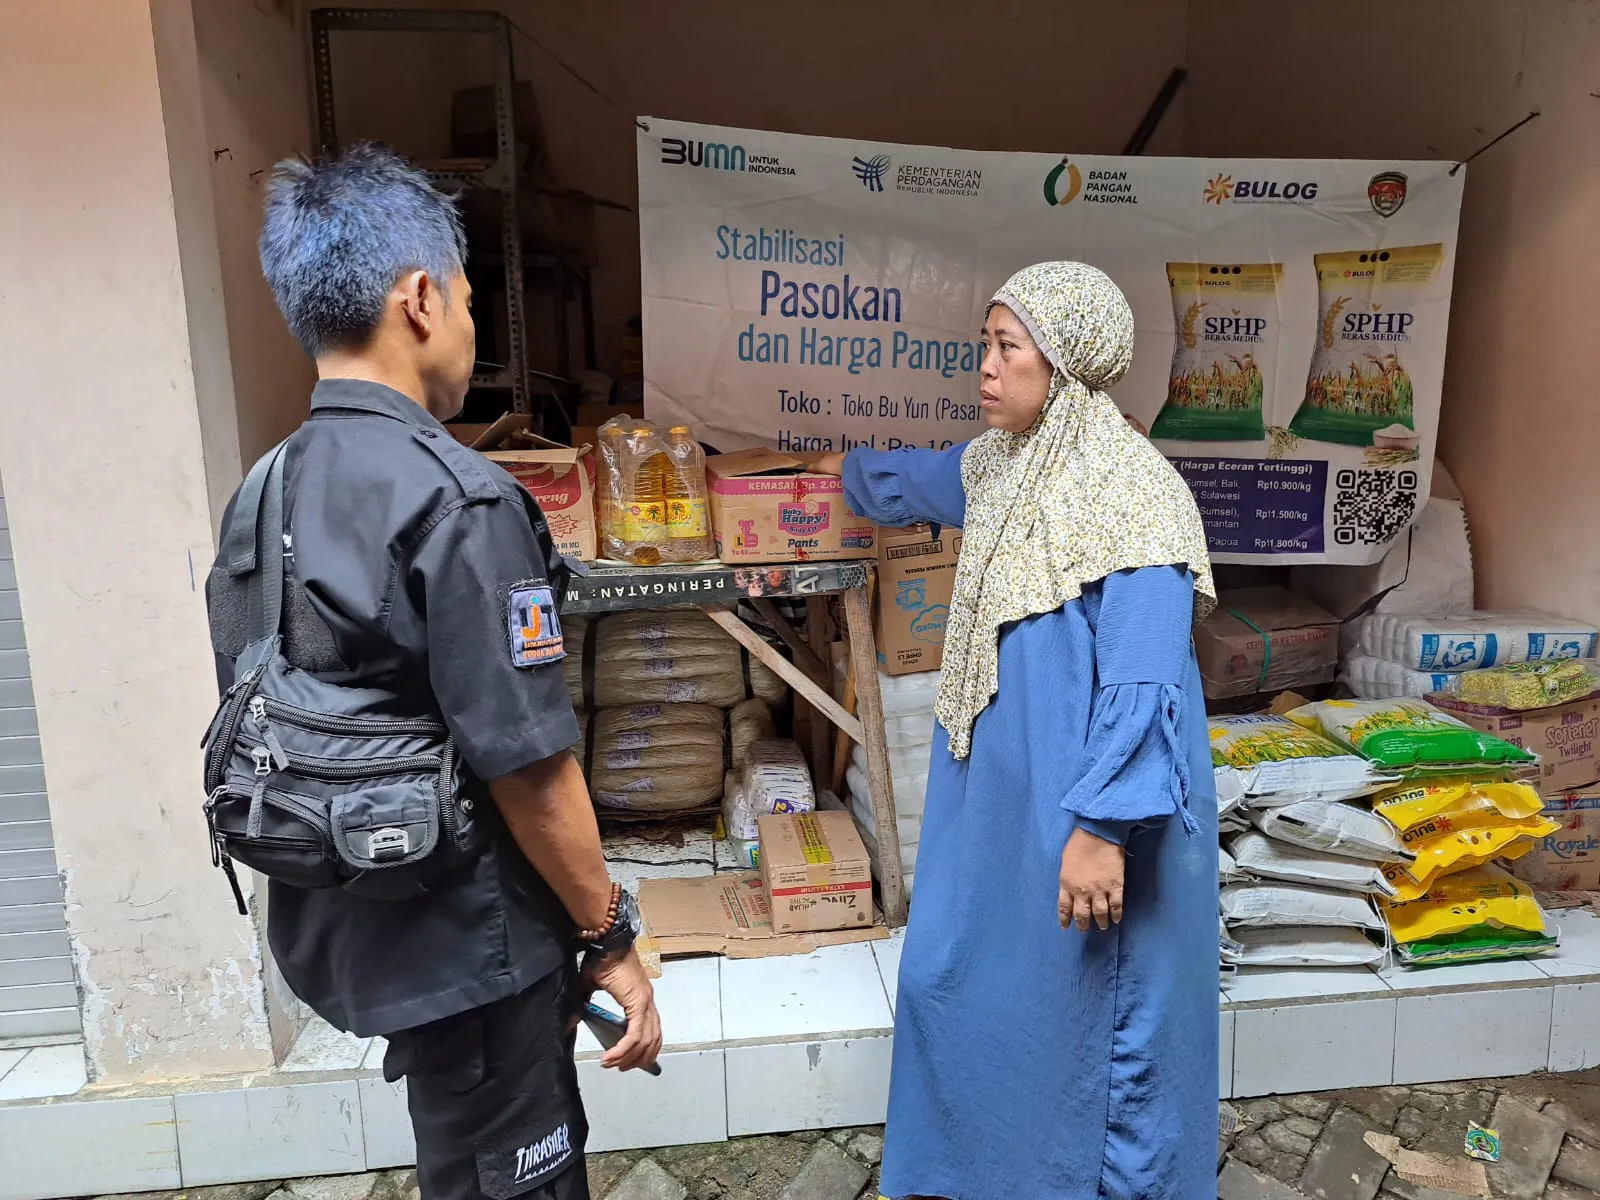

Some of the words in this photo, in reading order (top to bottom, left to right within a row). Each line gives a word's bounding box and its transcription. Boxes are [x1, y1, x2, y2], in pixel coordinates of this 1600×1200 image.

[749, 156, 780, 166] UNTUK
[748, 165, 796, 176] INDONESIA
[898, 165, 982, 179] KEMENTERIAN
[1088, 171, 1127, 181] BADAN
[897, 175, 980, 190] PERDAGANGAN
[1086, 183, 1132, 193] PANGAN
[896, 185, 934, 195] REPUBLIK
[936, 188, 978, 197] INDONESIA
[1234, 181, 1318, 200] BULOG
[1083, 194, 1138, 204] NASIONAL
[716, 224, 844, 267] Stabilisasi
[760, 270, 902, 323] Pasokan
[1204, 317, 1266, 336] SPHP
[1342, 313, 1414, 334] SPHP
[1341, 333, 1370, 341] BERAS
[738, 324, 789, 364] dan
[800, 327, 882, 374] Harga
[778, 390, 821, 414] Toko
[842, 394, 873, 417] Toko
[879, 396, 898, 418] Bu
[904, 396, 929, 419] Yun
[1180, 461, 1215, 472] (Harga
[1218, 461, 1254, 471] Eceran
[1258, 462, 1313, 474] Tertinggi)
[1257, 480, 1312, 492] Rp10.900/kg
[535, 493, 569, 504] reng
[1200, 491, 1240, 500] Sulawesi
[782, 511, 827, 525] Happy!
[1256, 509, 1308, 521] Rp11.500/kg
[787, 538, 819, 548] Pants
[1208, 537, 1239, 547] Papua
[592, 578, 725, 599] PERINGATAN:
[1559, 741, 1592, 757] Twilight
[1403, 822, 1436, 842] BULO
[514, 1122, 572, 1180] THRASHER
